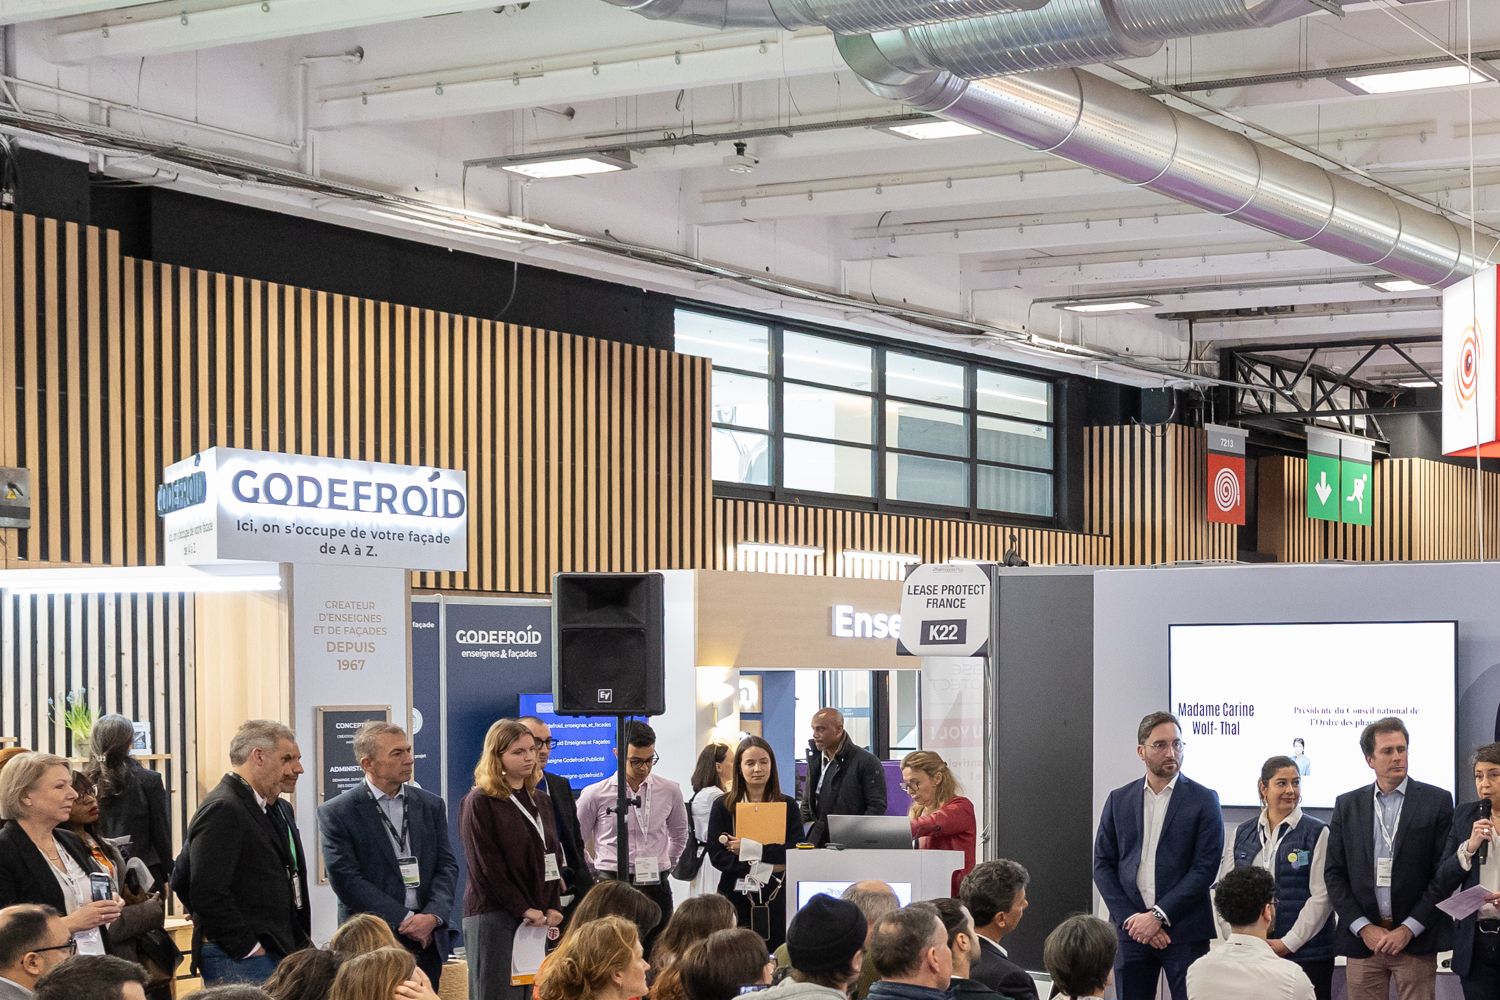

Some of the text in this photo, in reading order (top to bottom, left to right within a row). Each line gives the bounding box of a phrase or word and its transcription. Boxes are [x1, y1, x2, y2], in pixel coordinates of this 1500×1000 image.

[1220, 438, 1234, 448] 7213
[237, 520, 257, 534] Ici,
[262, 522, 280, 534] on
[350, 527, 367, 540] de
[370, 528, 404, 542] votre
[408, 530, 451, 546] façade
[319, 543, 378, 557] de A à Z.
[907, 584, 986, 596] LEASE PROTECT
[926, 598, 966, 609] FRANCE
[319, 613, 382, 623] D'ENSEIGNES
[313, 625, 388, 637] ET DE FAÇADES
[928, 624, 958, 641] K22
[326, 641, 376, 653] DEPUIS
[336, 659, 366, 671] 1967
[1178, 701, 1255, 717] Madame Carine
[1334, 706, 1345, 714] du
[1346, 706, 1375, 714] Conseil
[1376, 706, 1408, 714] national
[1409, 706, 1420, 714] de
[1340, 718, 1353, 726] des
[1191, 721, 1241, 736] Wolf- Thal
